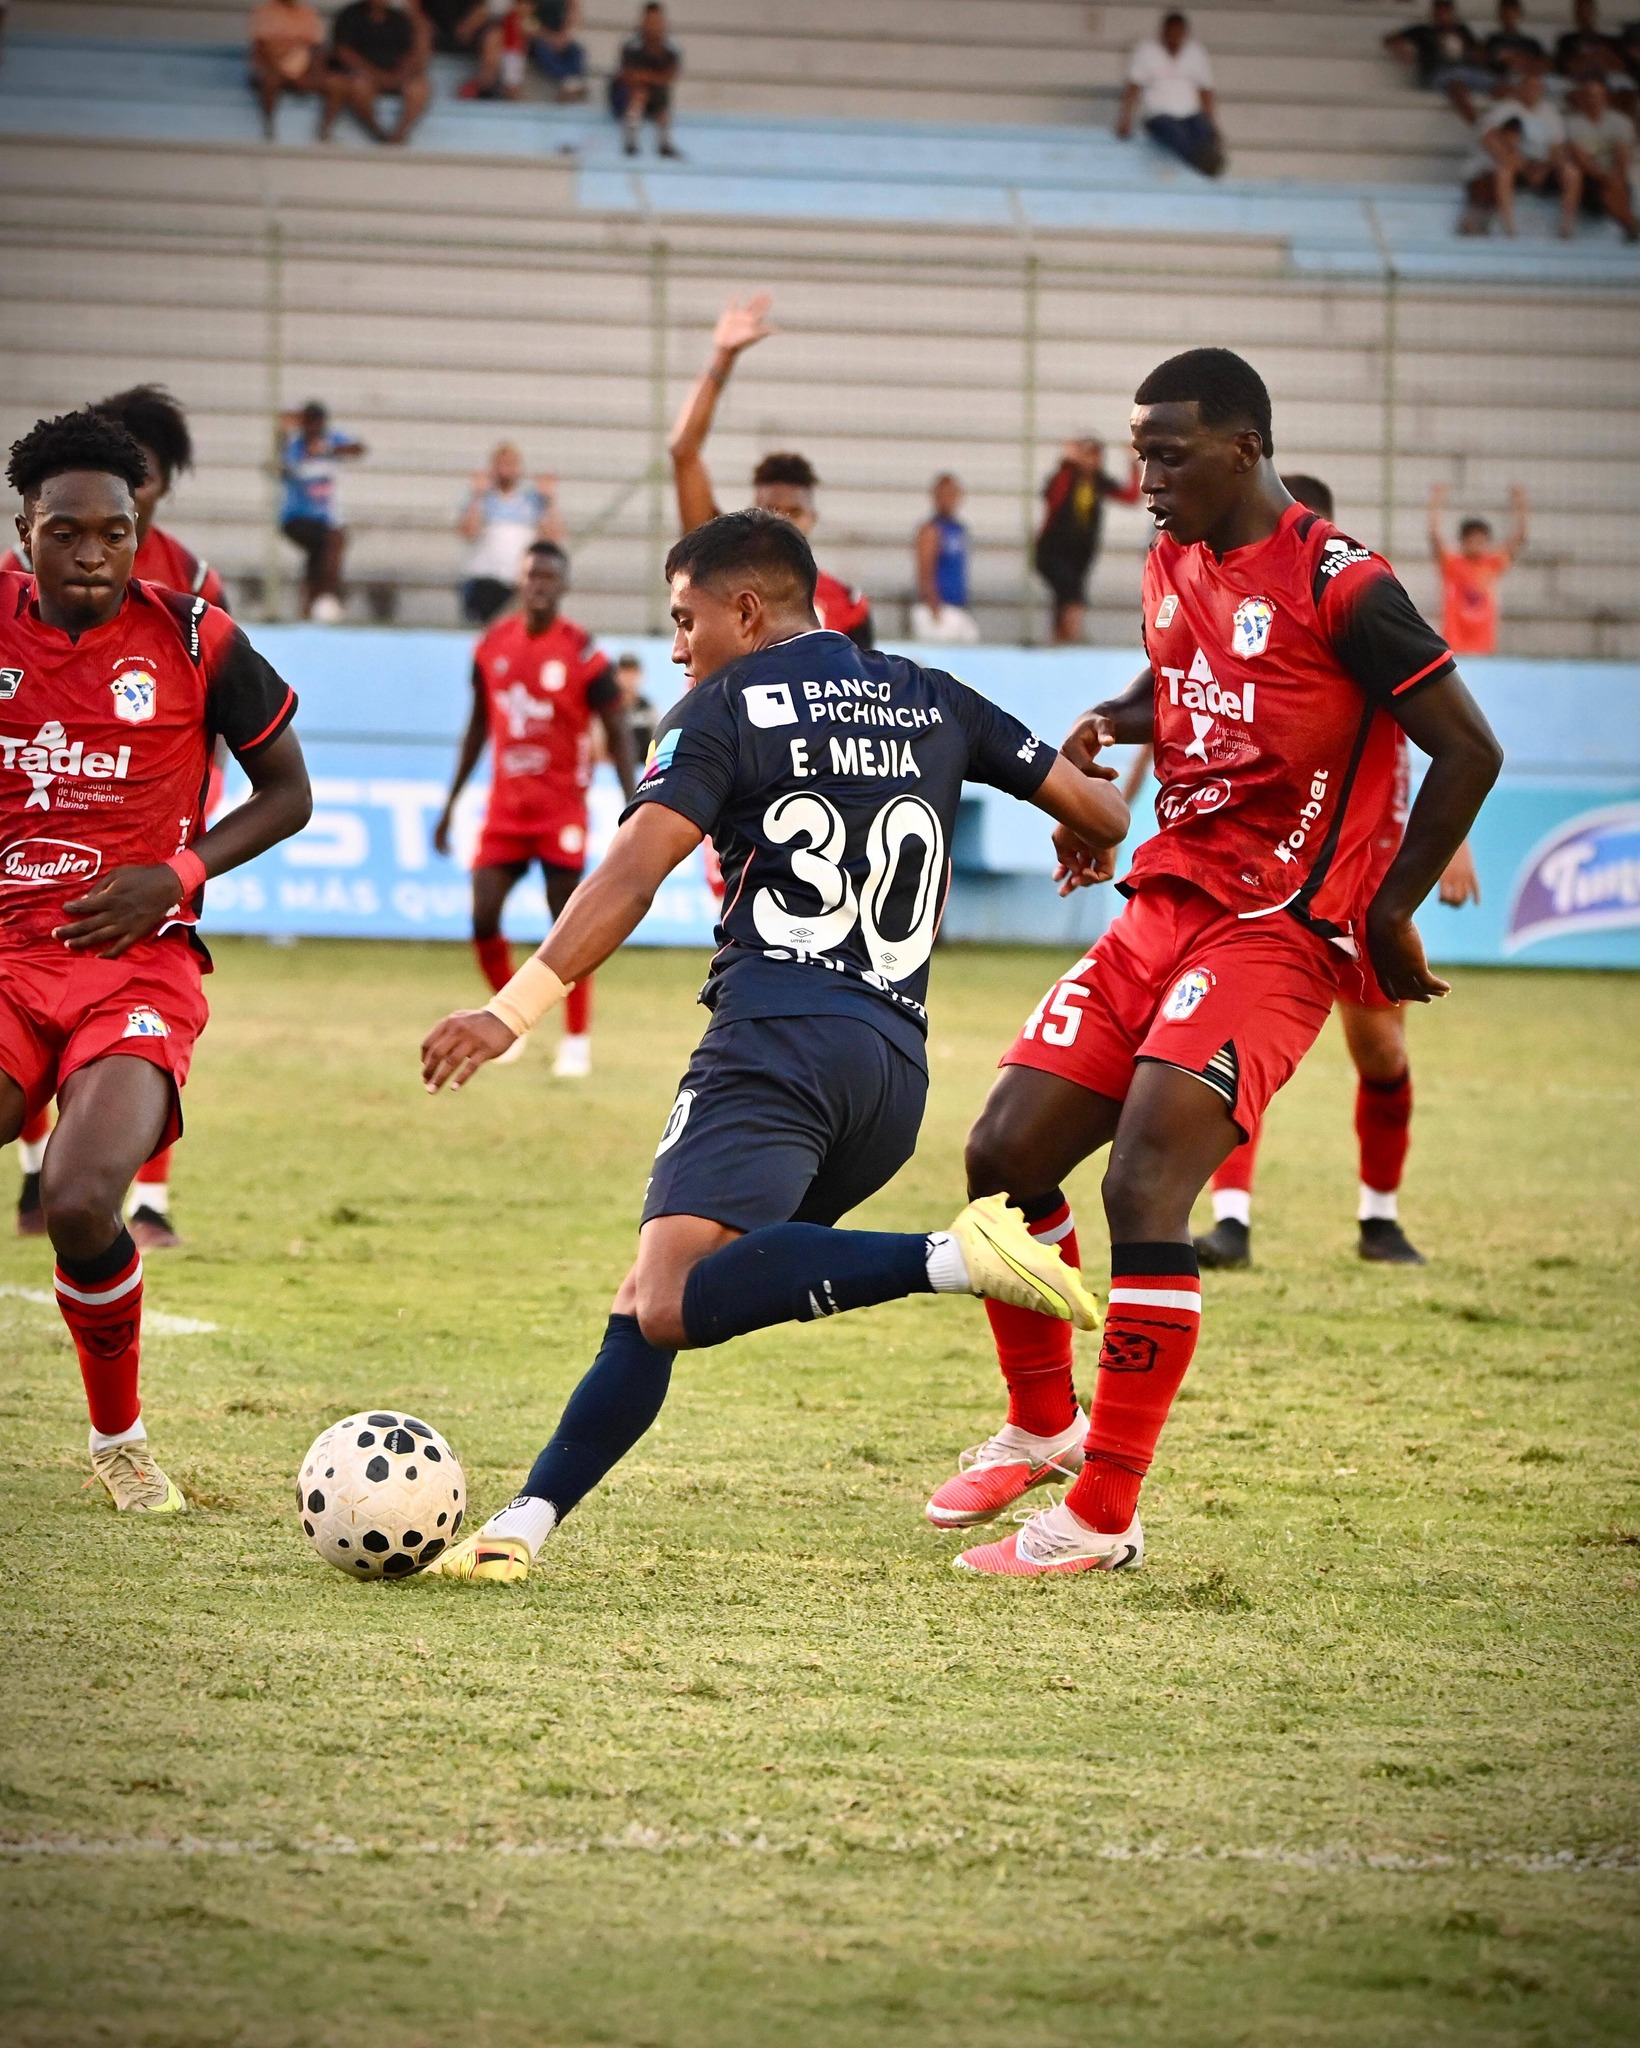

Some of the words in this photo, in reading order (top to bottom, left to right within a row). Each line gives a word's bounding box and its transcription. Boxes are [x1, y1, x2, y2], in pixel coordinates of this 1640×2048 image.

[803, 679, 891, 701] BANCO
[1160, 667, 1256, 723] Tadel
[809, 702, 944, 729] PICHINCHA
[0, 735, 132, 779] Tadel
[790, 738, 817, 778] E.
[829, 736, 921, 779] MEJIA
[55, 796, 89, 811] Marinos
[58, 787, 69, 797] de
[70, 787, 125, 805] Ingredientes
[5, 852, 90, 880] Tunalia
[752, 791, 946, 983] 30
